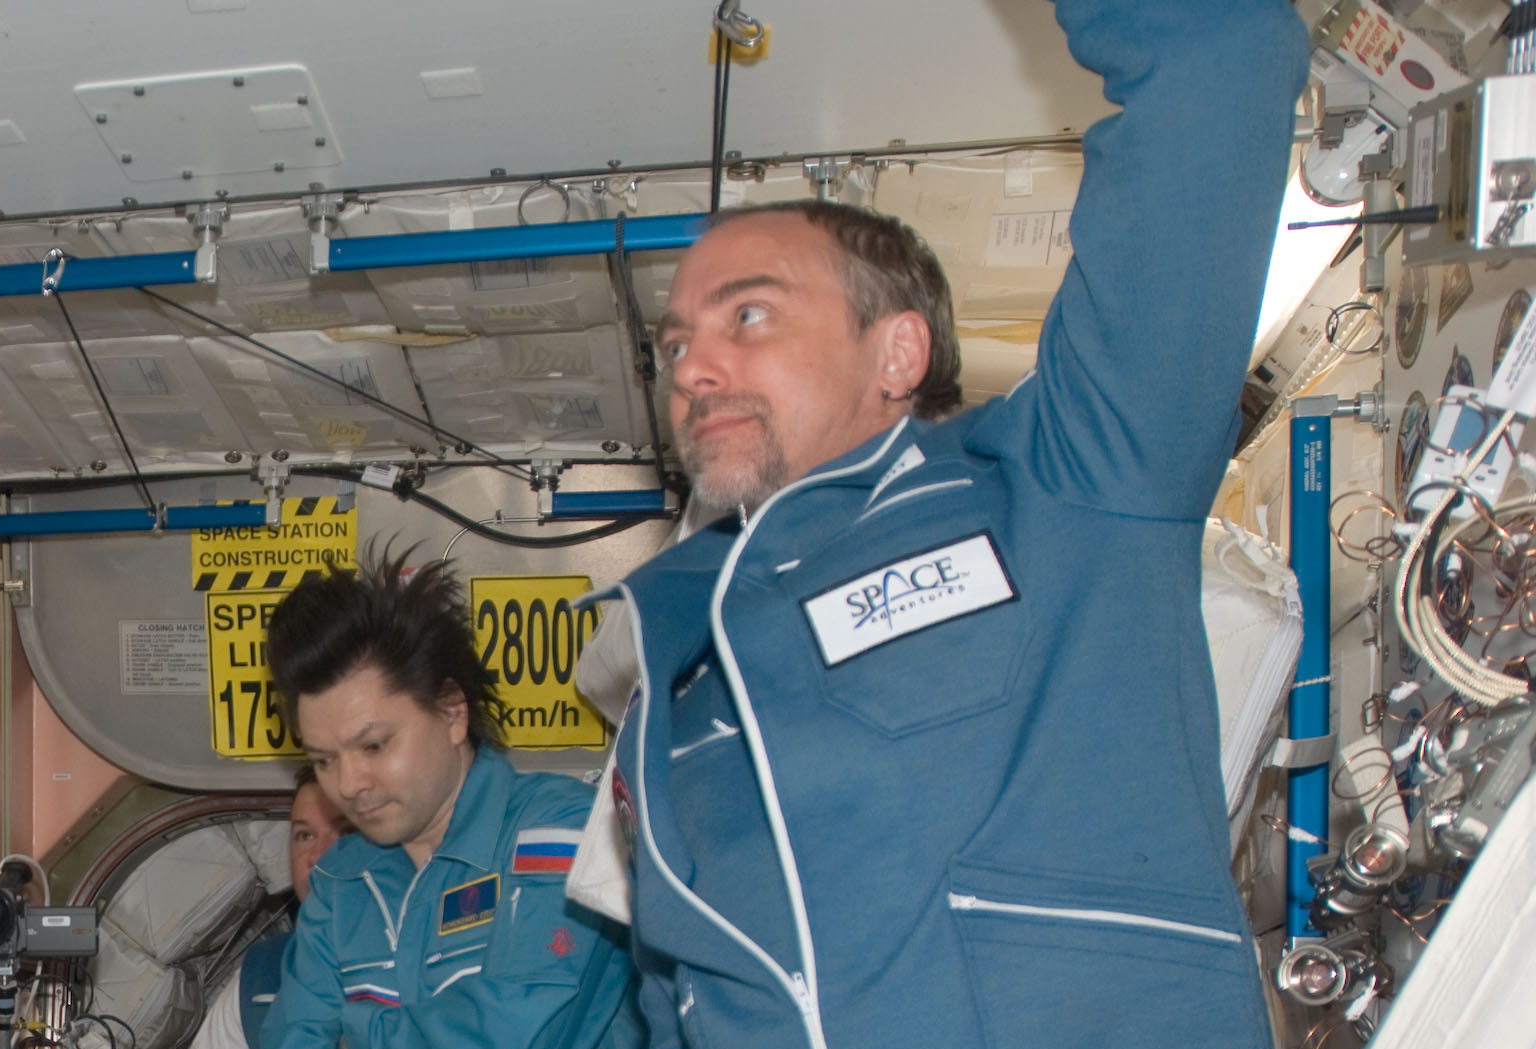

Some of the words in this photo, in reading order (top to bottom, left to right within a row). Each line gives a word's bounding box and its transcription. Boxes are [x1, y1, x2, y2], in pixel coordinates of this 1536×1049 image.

[199, 524, 261, 541] SPACE
[267, 522, 347, 539] STATION
[199, 548, 349, 567] CONSTRUCTION
[846, 556, 960, 620] SPACE
[214, 603, 276, 630] SPE
[871, 584, 966, 624] adventures
[138, 623, 174, 632] CLOSING
[177, 623, 205, 632] HATCH
[219, 679, 303, 749] 175
